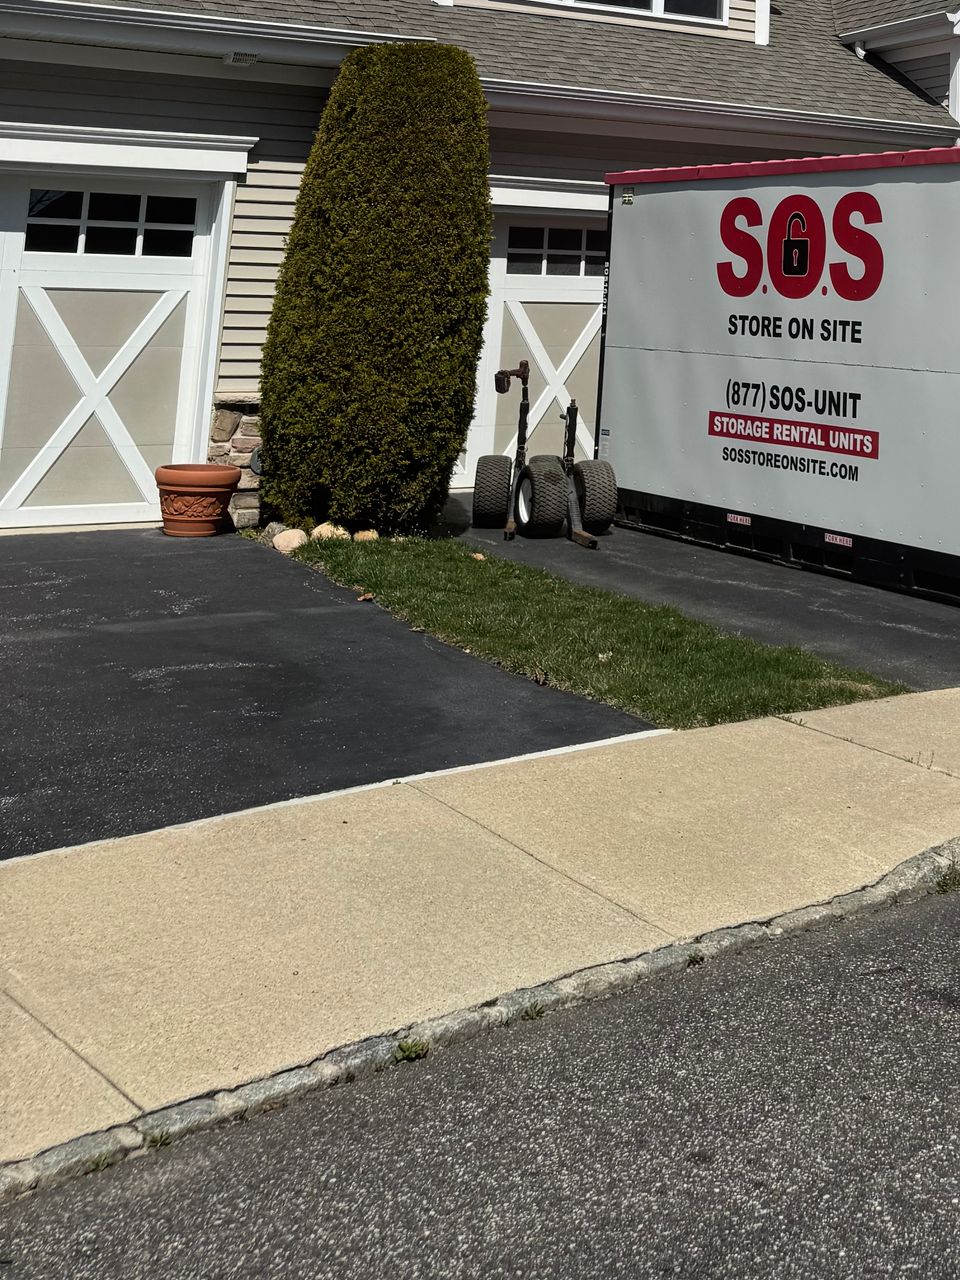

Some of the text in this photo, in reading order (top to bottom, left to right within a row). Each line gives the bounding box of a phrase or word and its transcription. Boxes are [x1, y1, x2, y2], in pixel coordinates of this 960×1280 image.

[717, 191, 884, 301] S.O.S
[727, 314, 863, 344] STORE ON SITE
[725, 378, 862, 419] (877) SOS-UNIT
[713, 416, 873, 454] STORAGE RENTAL UNITS
[722, 446, 859, 482] SOSSTOREONSITE.COM
